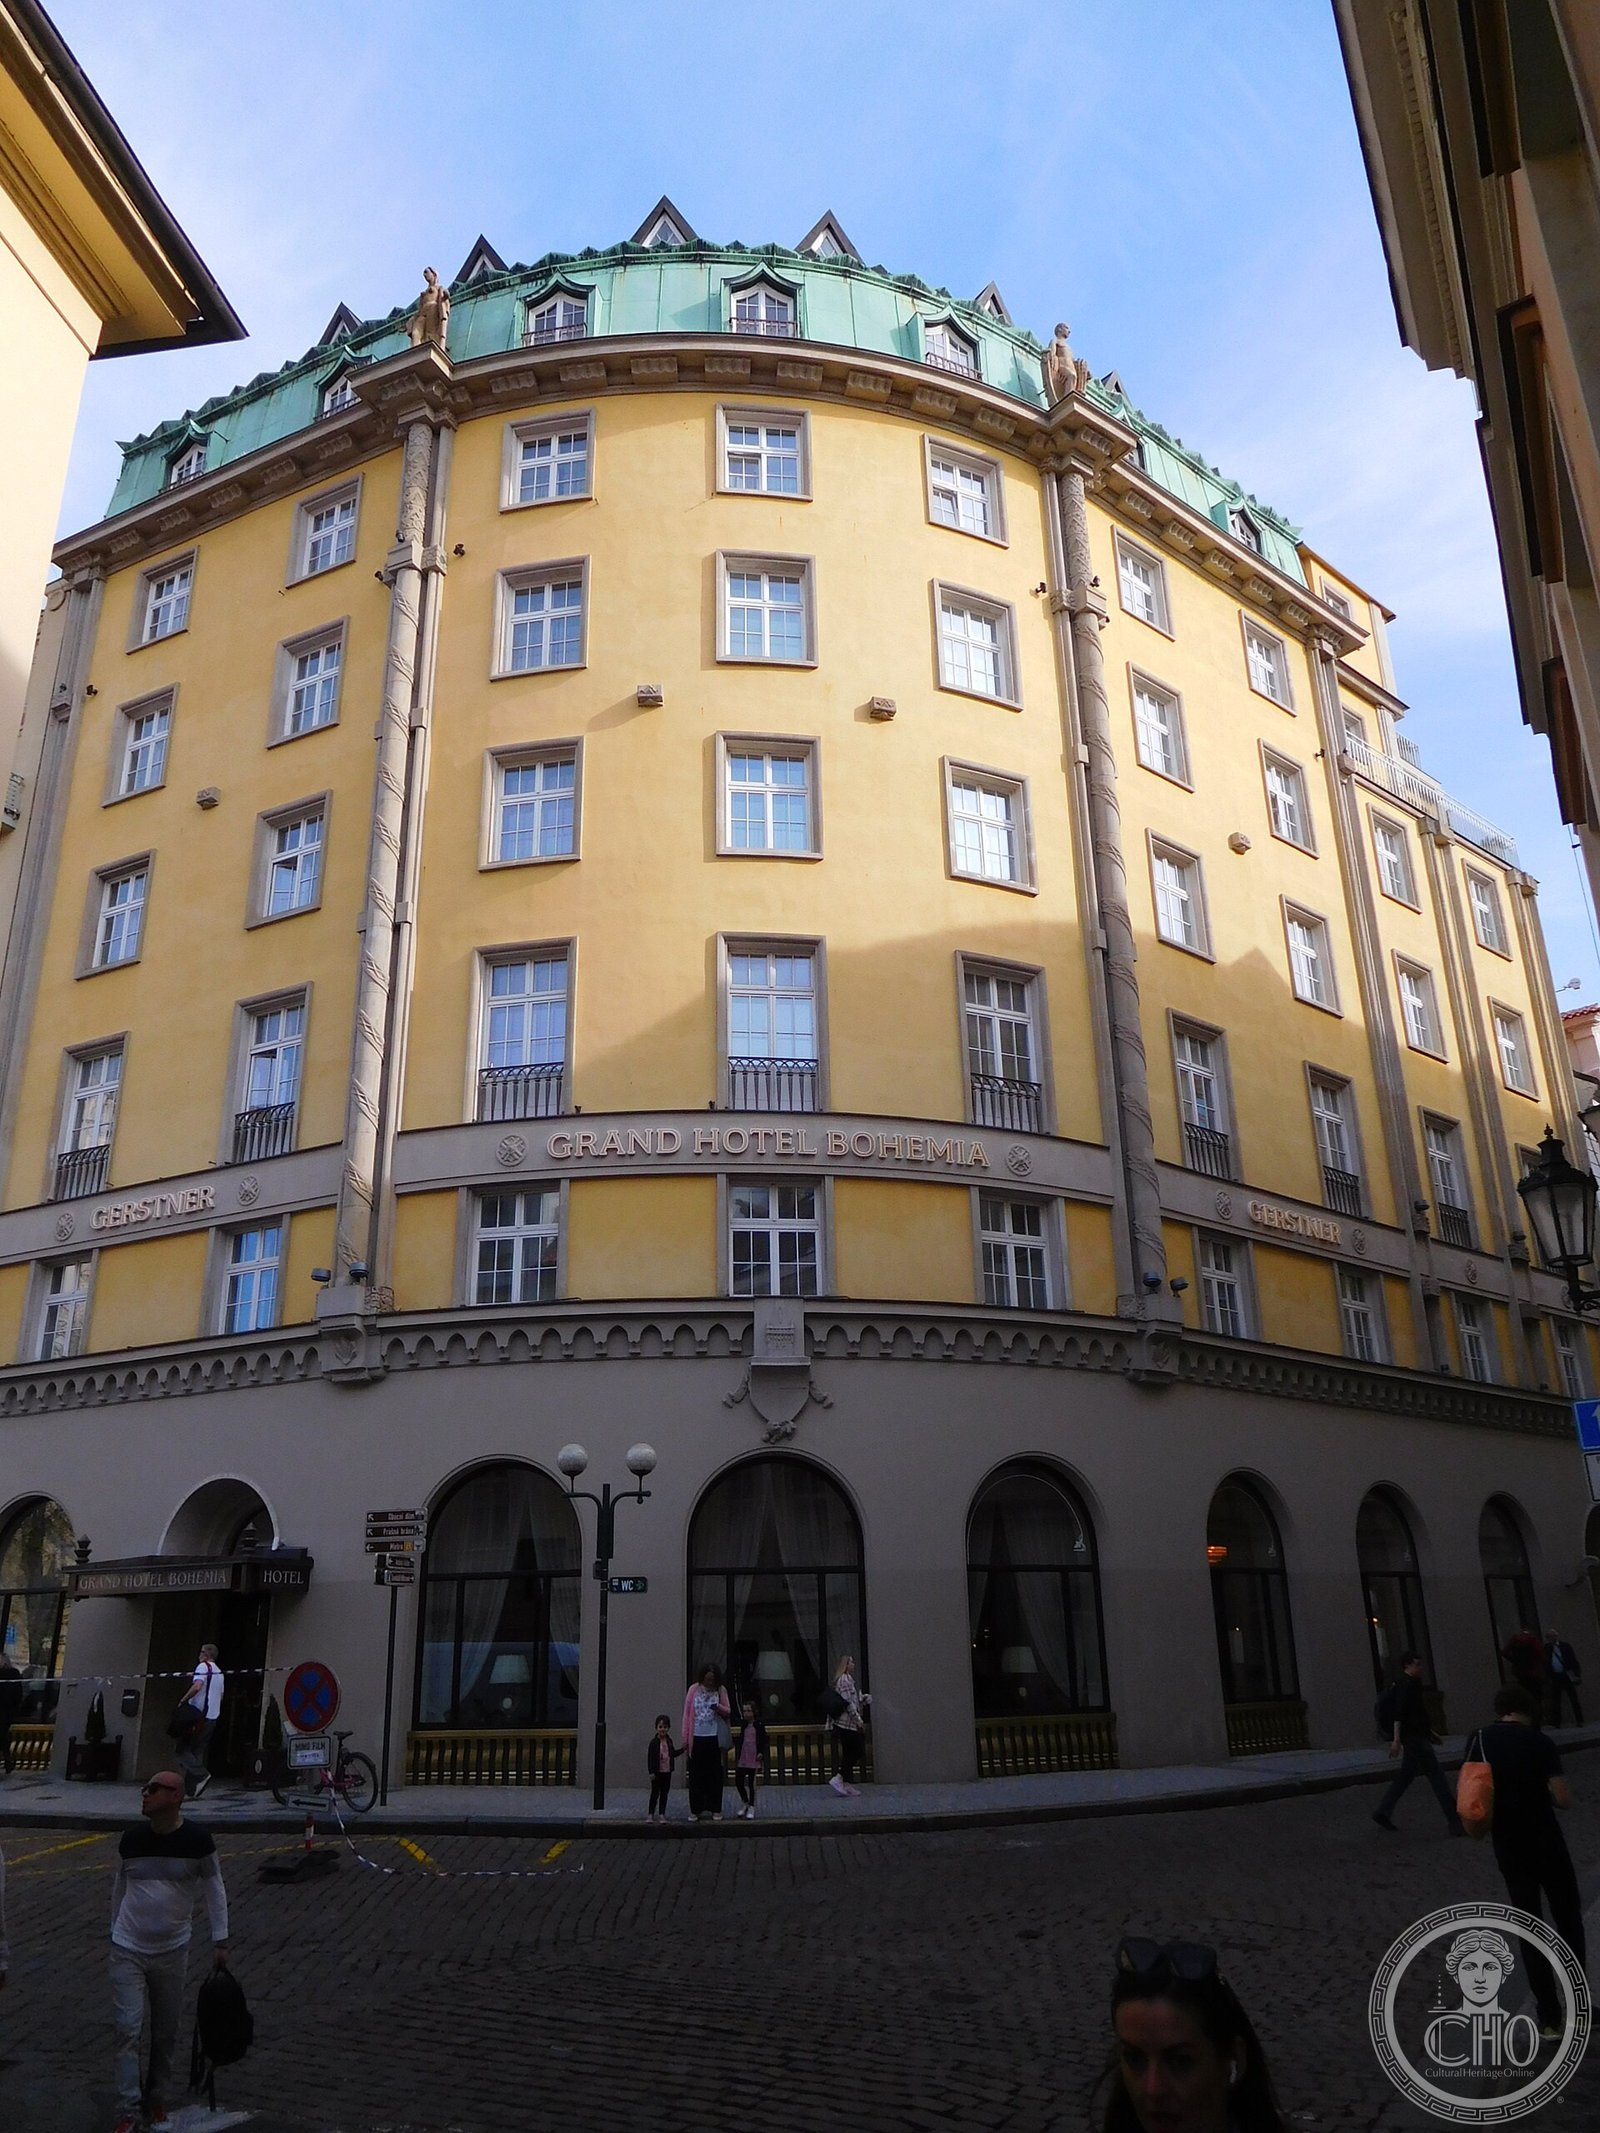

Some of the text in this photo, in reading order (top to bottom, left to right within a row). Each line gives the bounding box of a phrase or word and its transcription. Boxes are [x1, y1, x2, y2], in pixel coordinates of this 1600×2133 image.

[547, 1127, 991, 1168] GRAND HOTEL BOHEMIA
[89, 1185, 216, 1230] GERSTNER
[1247, 1199, 1342, 1245] GERSTNER
[79, 1569, 226, 1590] GRAND HOTEL BOHEMIA
[263, 1569, 304, 1584] HOTEL
[621, 1579, 634, 1591] WC
